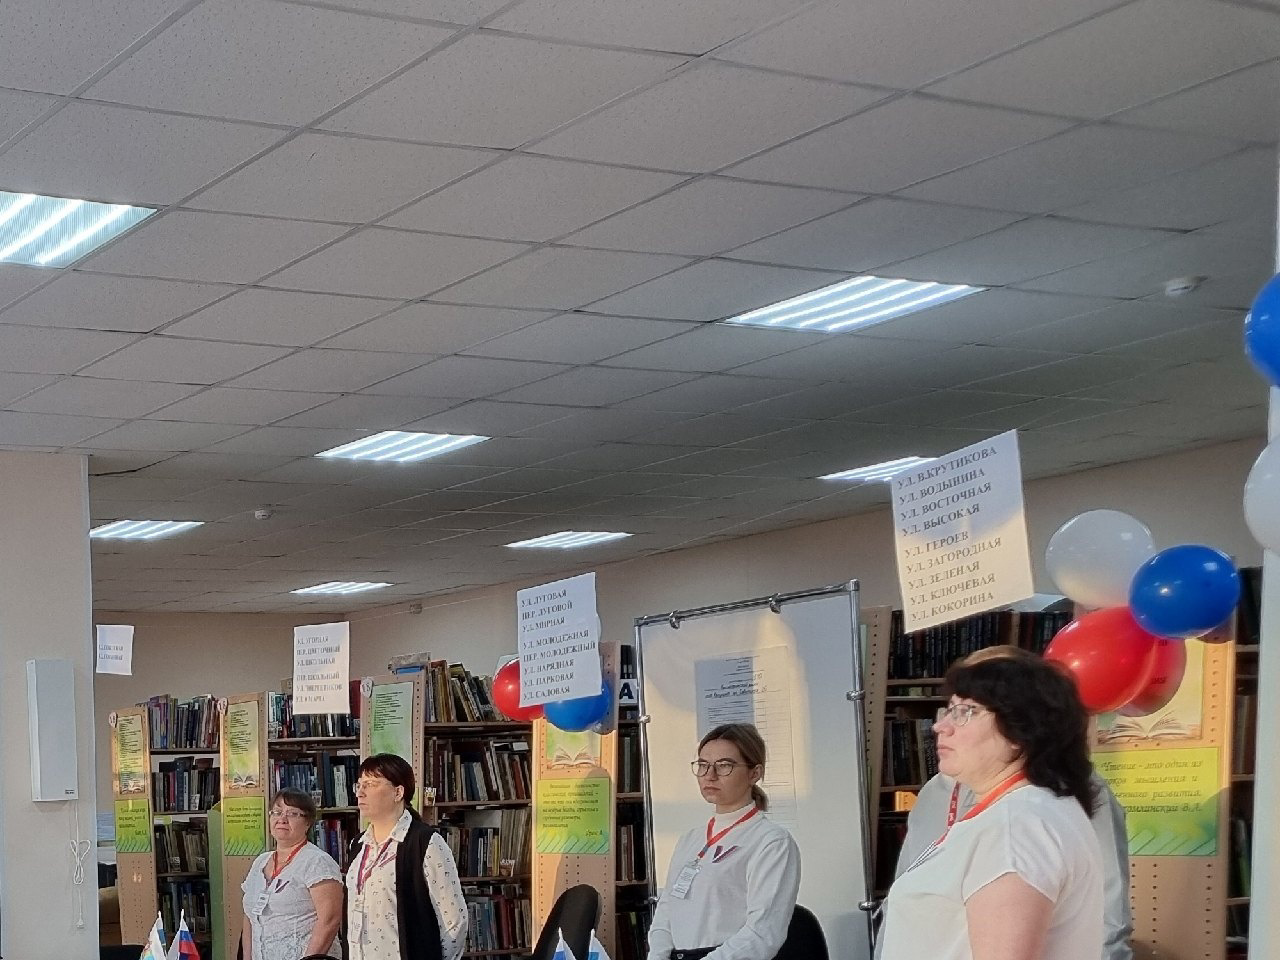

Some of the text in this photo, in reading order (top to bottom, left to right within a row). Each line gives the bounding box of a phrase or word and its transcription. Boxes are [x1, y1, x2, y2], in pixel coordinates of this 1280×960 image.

[898, 477, 916, 490] УЛ.
[900, 467, 985, 506] УЛ. ВОДЫНИНА
[901, 482, 992, 521] УЛ. ВОСТОЧНАЯ
[902, 503, 980, 537] УЛ. ВЫСОКАЯ
[904, 531, 969, 558] УЛ. ГЕРОЕВ
[906, 537, 1002, 574] УЛ. ЗАГОРОДНАЯ
[908, 561, 980, 590] УЛ. ЗЕЛЕНАЯ
[910, 573, 995, 606] УЛ. КЛЮЧЕВАЯ
[911, 592, 994, 622] УЛ. КОКОРИНА
